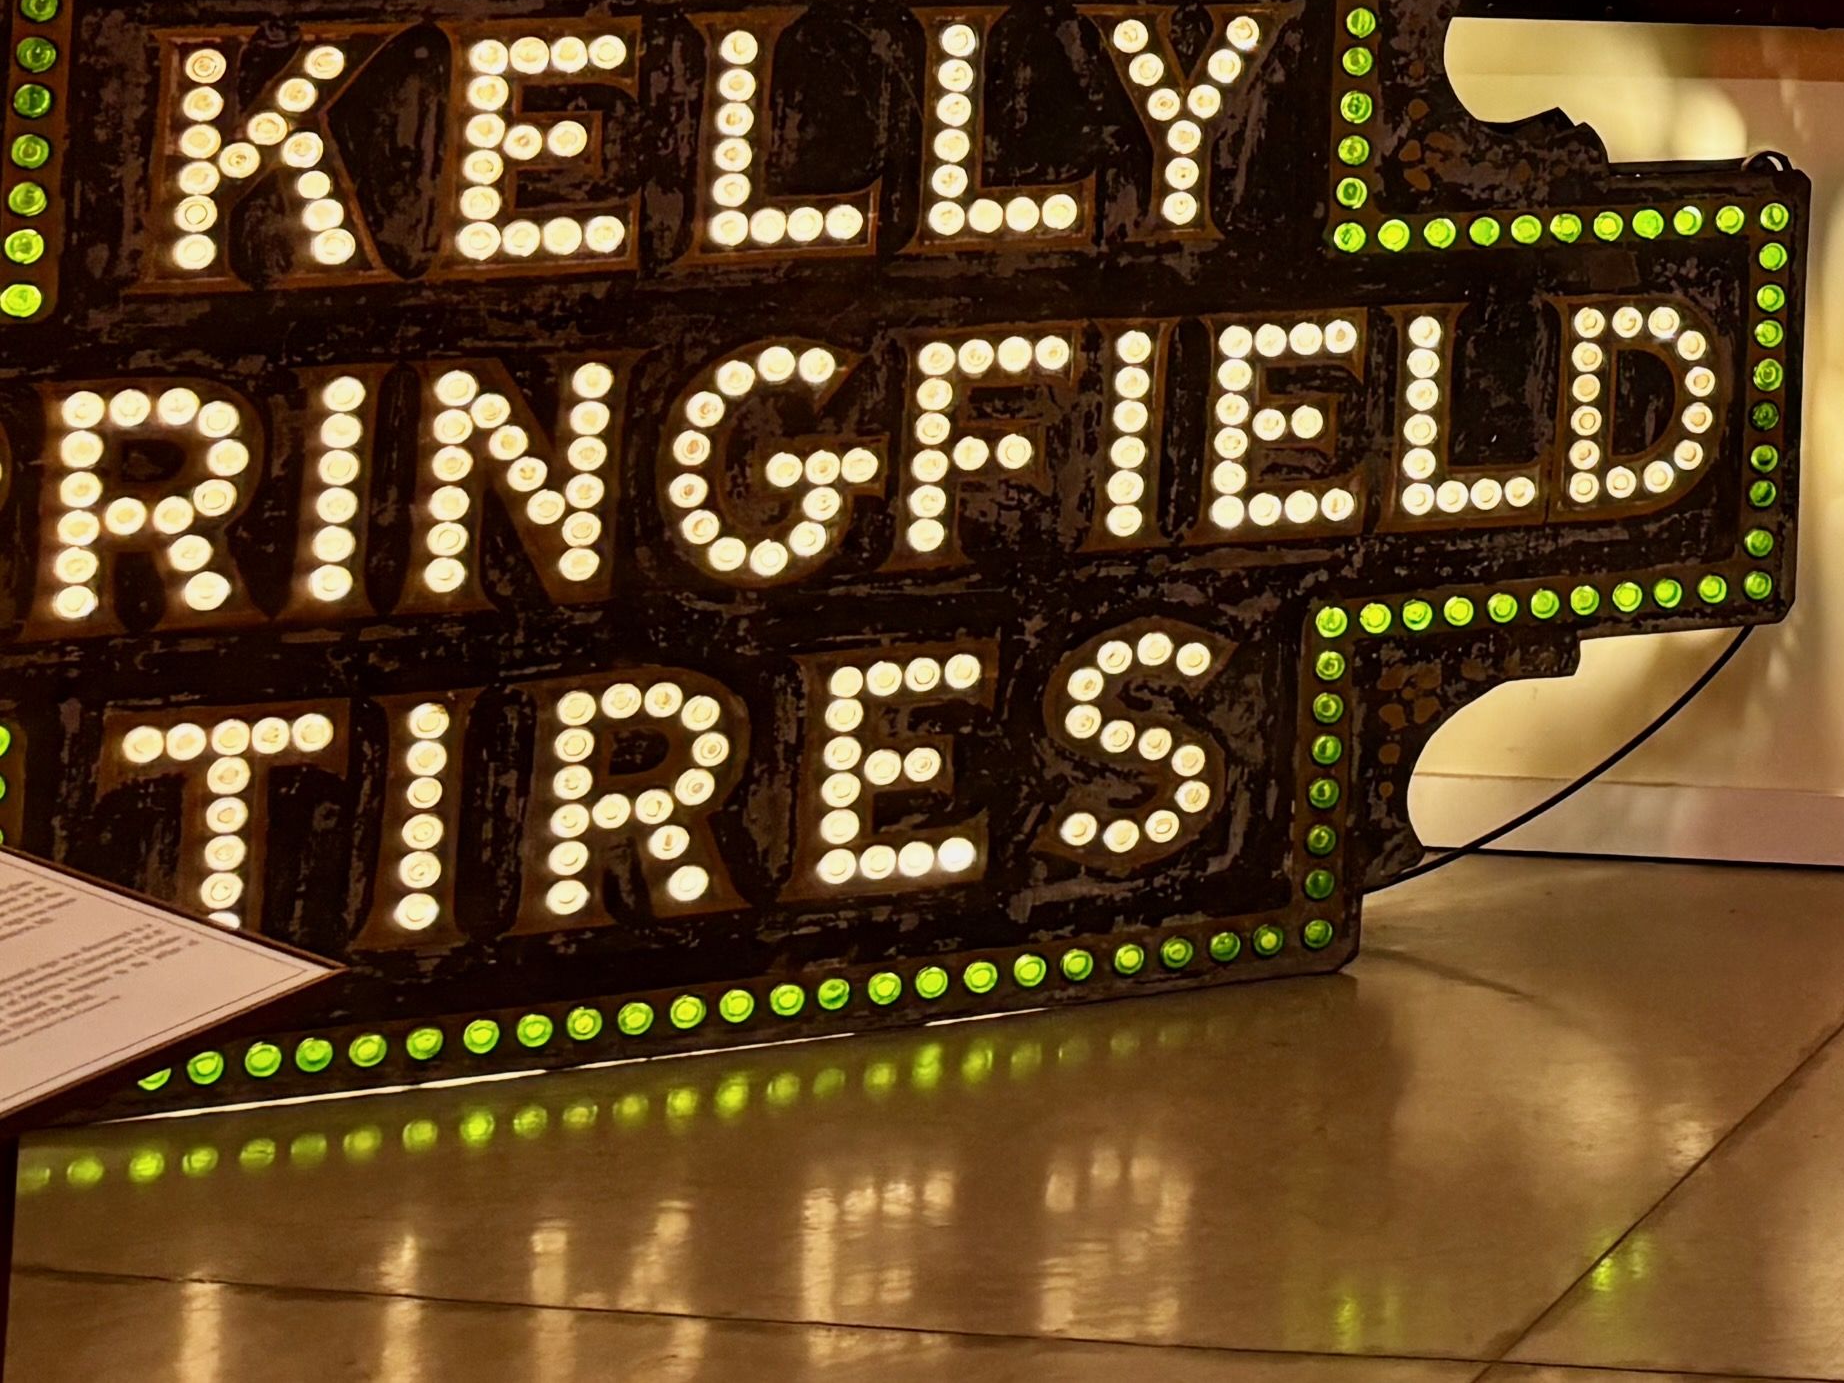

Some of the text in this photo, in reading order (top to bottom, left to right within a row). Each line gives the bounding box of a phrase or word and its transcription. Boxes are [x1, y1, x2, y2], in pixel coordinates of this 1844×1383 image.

[158, 0, 1300, 290] KELLY
[25, 295, 1728, 627] RINGFIELD
[110, 617, 1230, 933] TIRES
